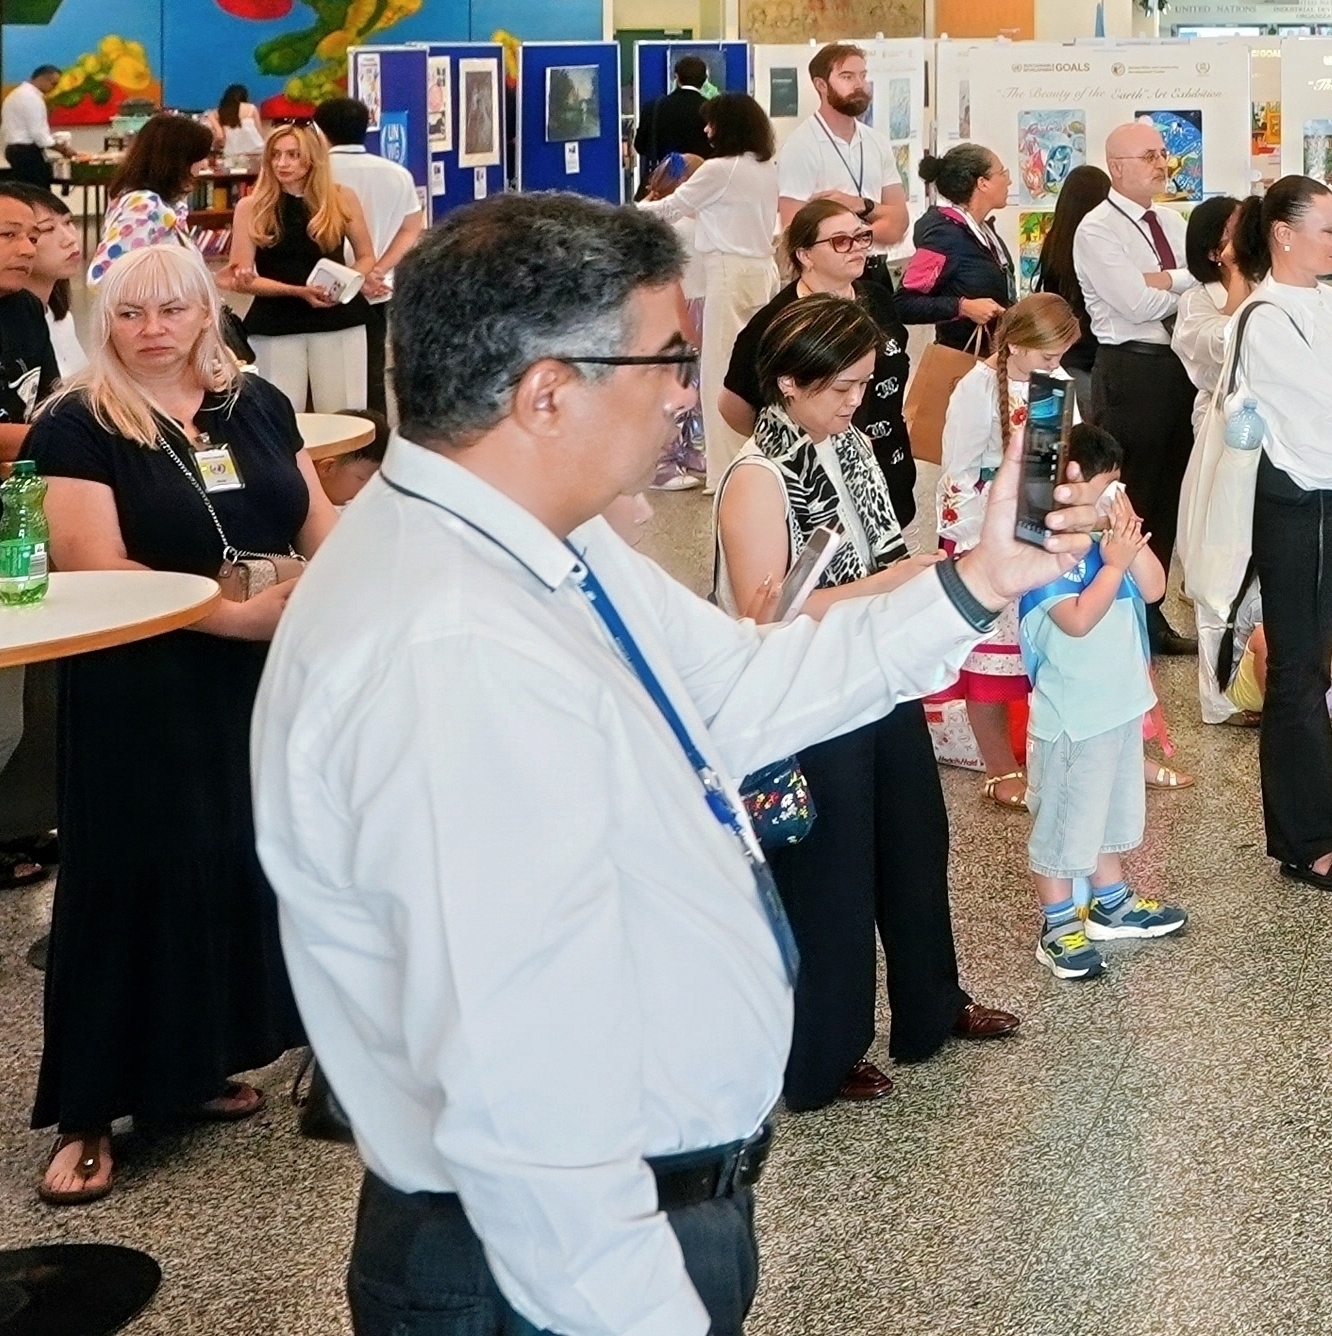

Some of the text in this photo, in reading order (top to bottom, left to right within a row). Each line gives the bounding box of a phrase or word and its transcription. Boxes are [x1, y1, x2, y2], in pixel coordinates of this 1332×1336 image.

[1174, 4, 1257, 13] UNITED NATIONS
[1056, 63, 1090, 72] GOALS
[1029, 86, 1070, 101] Beauty
[1074, 85, 1087, 102] of
[1088, 86, 1106, 98] the
[1149, 87, 1168, 99] Art
[1170, 87, 1222, 99] Exhibition
